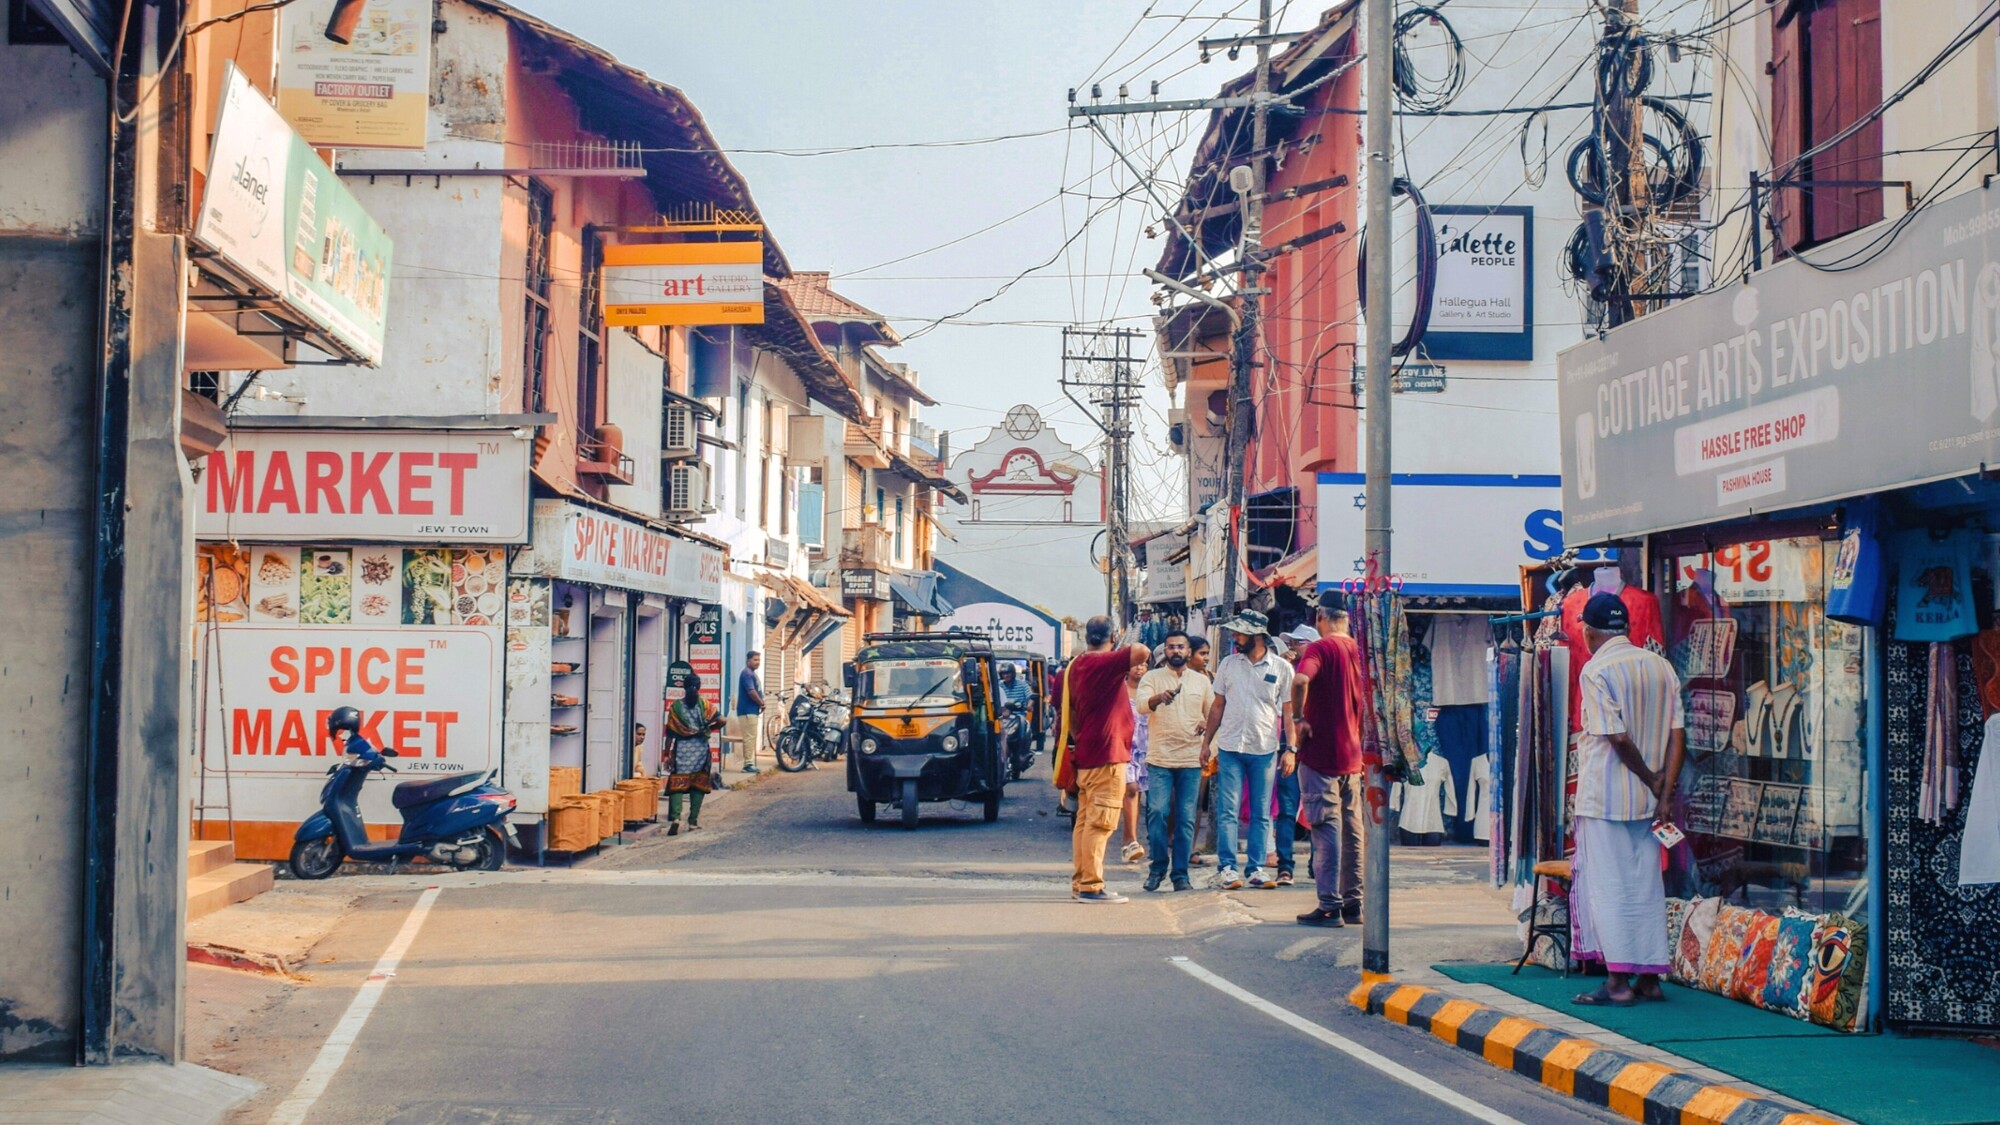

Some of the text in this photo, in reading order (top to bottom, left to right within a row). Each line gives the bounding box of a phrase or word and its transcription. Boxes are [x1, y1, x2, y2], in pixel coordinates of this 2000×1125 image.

[316, 83, 390, 98] FACTORY OUTLET
[1471, 257, 1516, 266] PEOPLE
[712, 275, 748, 283] STUDIO
[663, 273, 705, 296] art
[707, 284, 752, 293] GALLERY
[1439, 297, 1511, 309] Hallegua Hall
[1439, 310, 1464, 319] Gallery
[1475, 310, 1486, 318] Art
[1488, 311, 1512, 319] Studio
[1597, 257, 1967, 439] COTTAGE ARTS EXPOSITION
[1701, 412, 1806, 461] HASSLE FREE SHOP
[206, 442, 500, 516] MARKET TM
[1197, 477, 1221, 487] YOUR
[1722, 467, 1773, 494] PASHMINA HOUSE
[418, 525, 489, 534] JEW TOWN
[574, 515, 672, 577] SPICE MARKET
[1156, 565, 1180, 573] SHAWLS
[845, 575, 872, 583] ORGANIC
[1159, 581, 1180, 589] SILVER
[694, 622, 717, 634] OILS
[268, 640, 448, 695] SPICE TM
[711, 663, 719, 671] OIL
[710, 677, 719, 685] OIL
[407, 763, 464, 771] JEW TOWN
